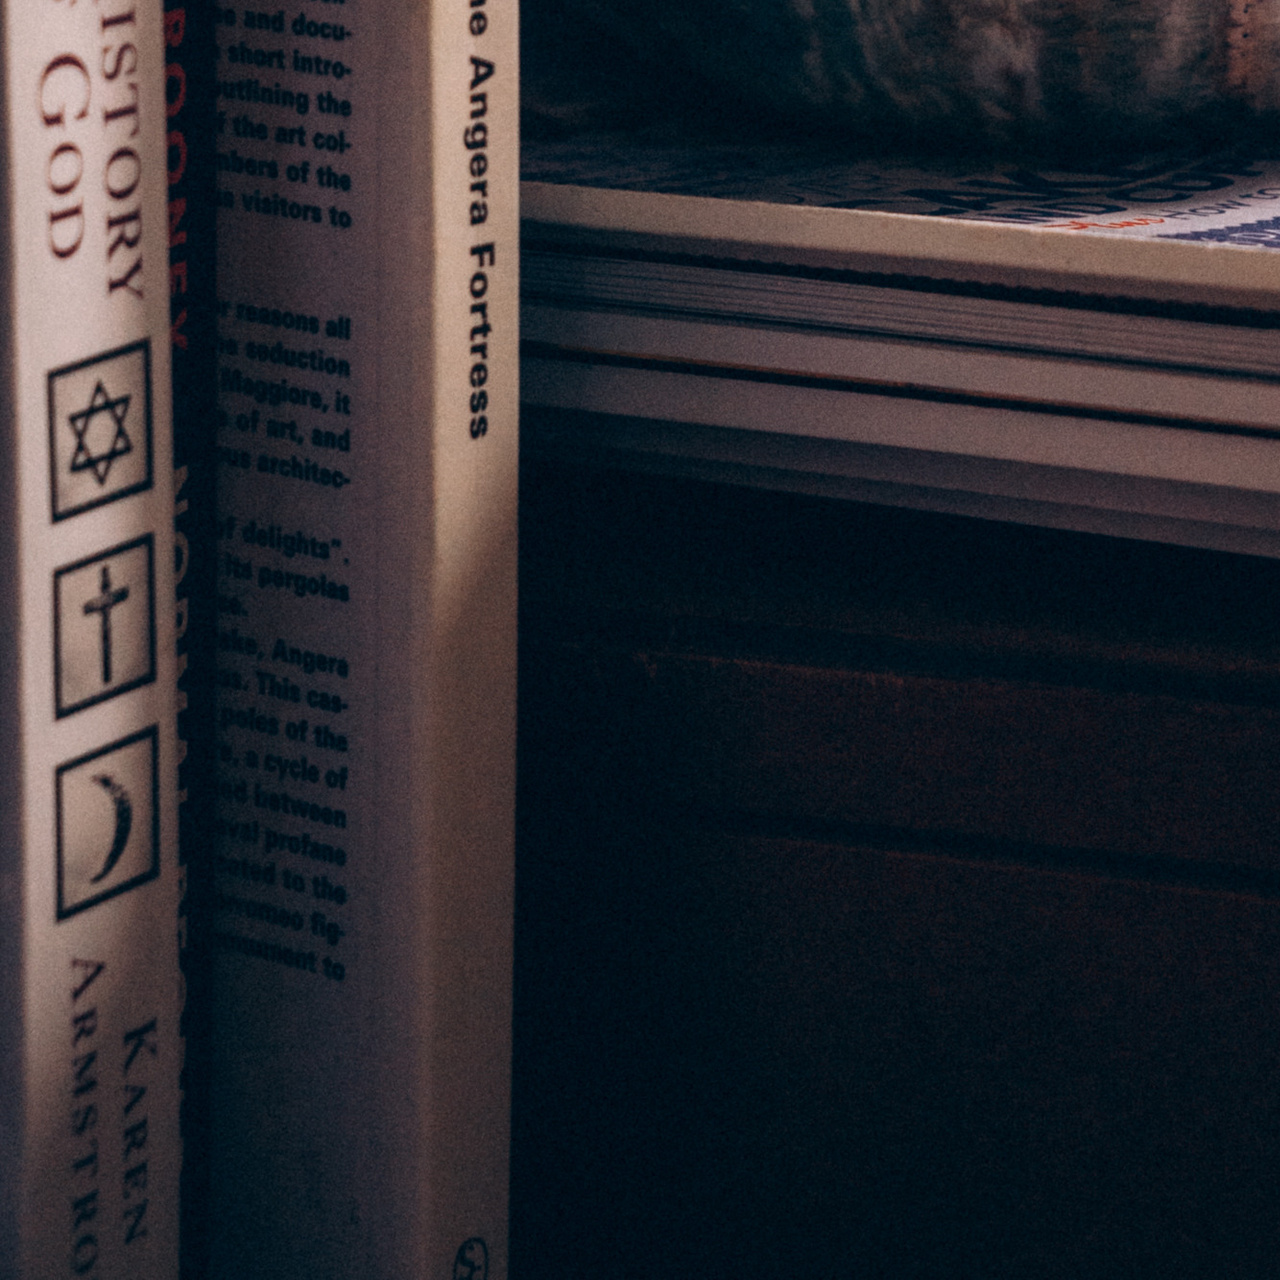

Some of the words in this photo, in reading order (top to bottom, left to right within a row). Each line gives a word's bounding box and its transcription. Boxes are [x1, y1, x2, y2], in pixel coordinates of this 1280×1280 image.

[244, 9, 284, 33] and
[292, 13, 351, 41] docu-
[228, 42, 285, 70] short
[293, 50, 351, 78] intro-
[318, 92, 351, 116] the
[234, 116, 267, 140] the
[275, 125, 305, 146] art
[313, 131, 351, 153] col-
[464, 55, 495, 226] Angera
[38, 53, 91, 261] GOD
[287, 162, 309, 183] of
[318, 167, 351, 191] the
[242, 190, 321, 223] visitors
[330, 208, 351, 227] to
[237, 303, 319, 333] reasons
[326, 316, 350, 339] all
[246, 342, 349, 377] seduction
[469, 241, 495, 441] Fortress
[221, 368, 329, 413] Maggiore,
[335, 391, 350, 415] it
[236, 410, 259, 433] of
[267, 419, 303, 445] art,
[312, 428, 349, 451] and
[257, 454, 350, 488] architec-
[259, 566, 349, 602] pergolas
[272, 639, 348, 677] Angera
[256, 671, 300, 702] This
[307, 689, 348, 713] cas-
[286, 720, 307, 742] of
[315, 725, 347, 751] the
[246, 750, 258, 767] a
[264, 754, 319, 783] cycle
[326, 767, 347, 789] of
[255, 783, 346, 828] between
[265, 829, 346, 866] profane
[283, 870, 304, 892] to
[313, 876, 346, 904] the
[323, 956, 344, 981] to
[123, 1017, 157, 1246] KAREN
